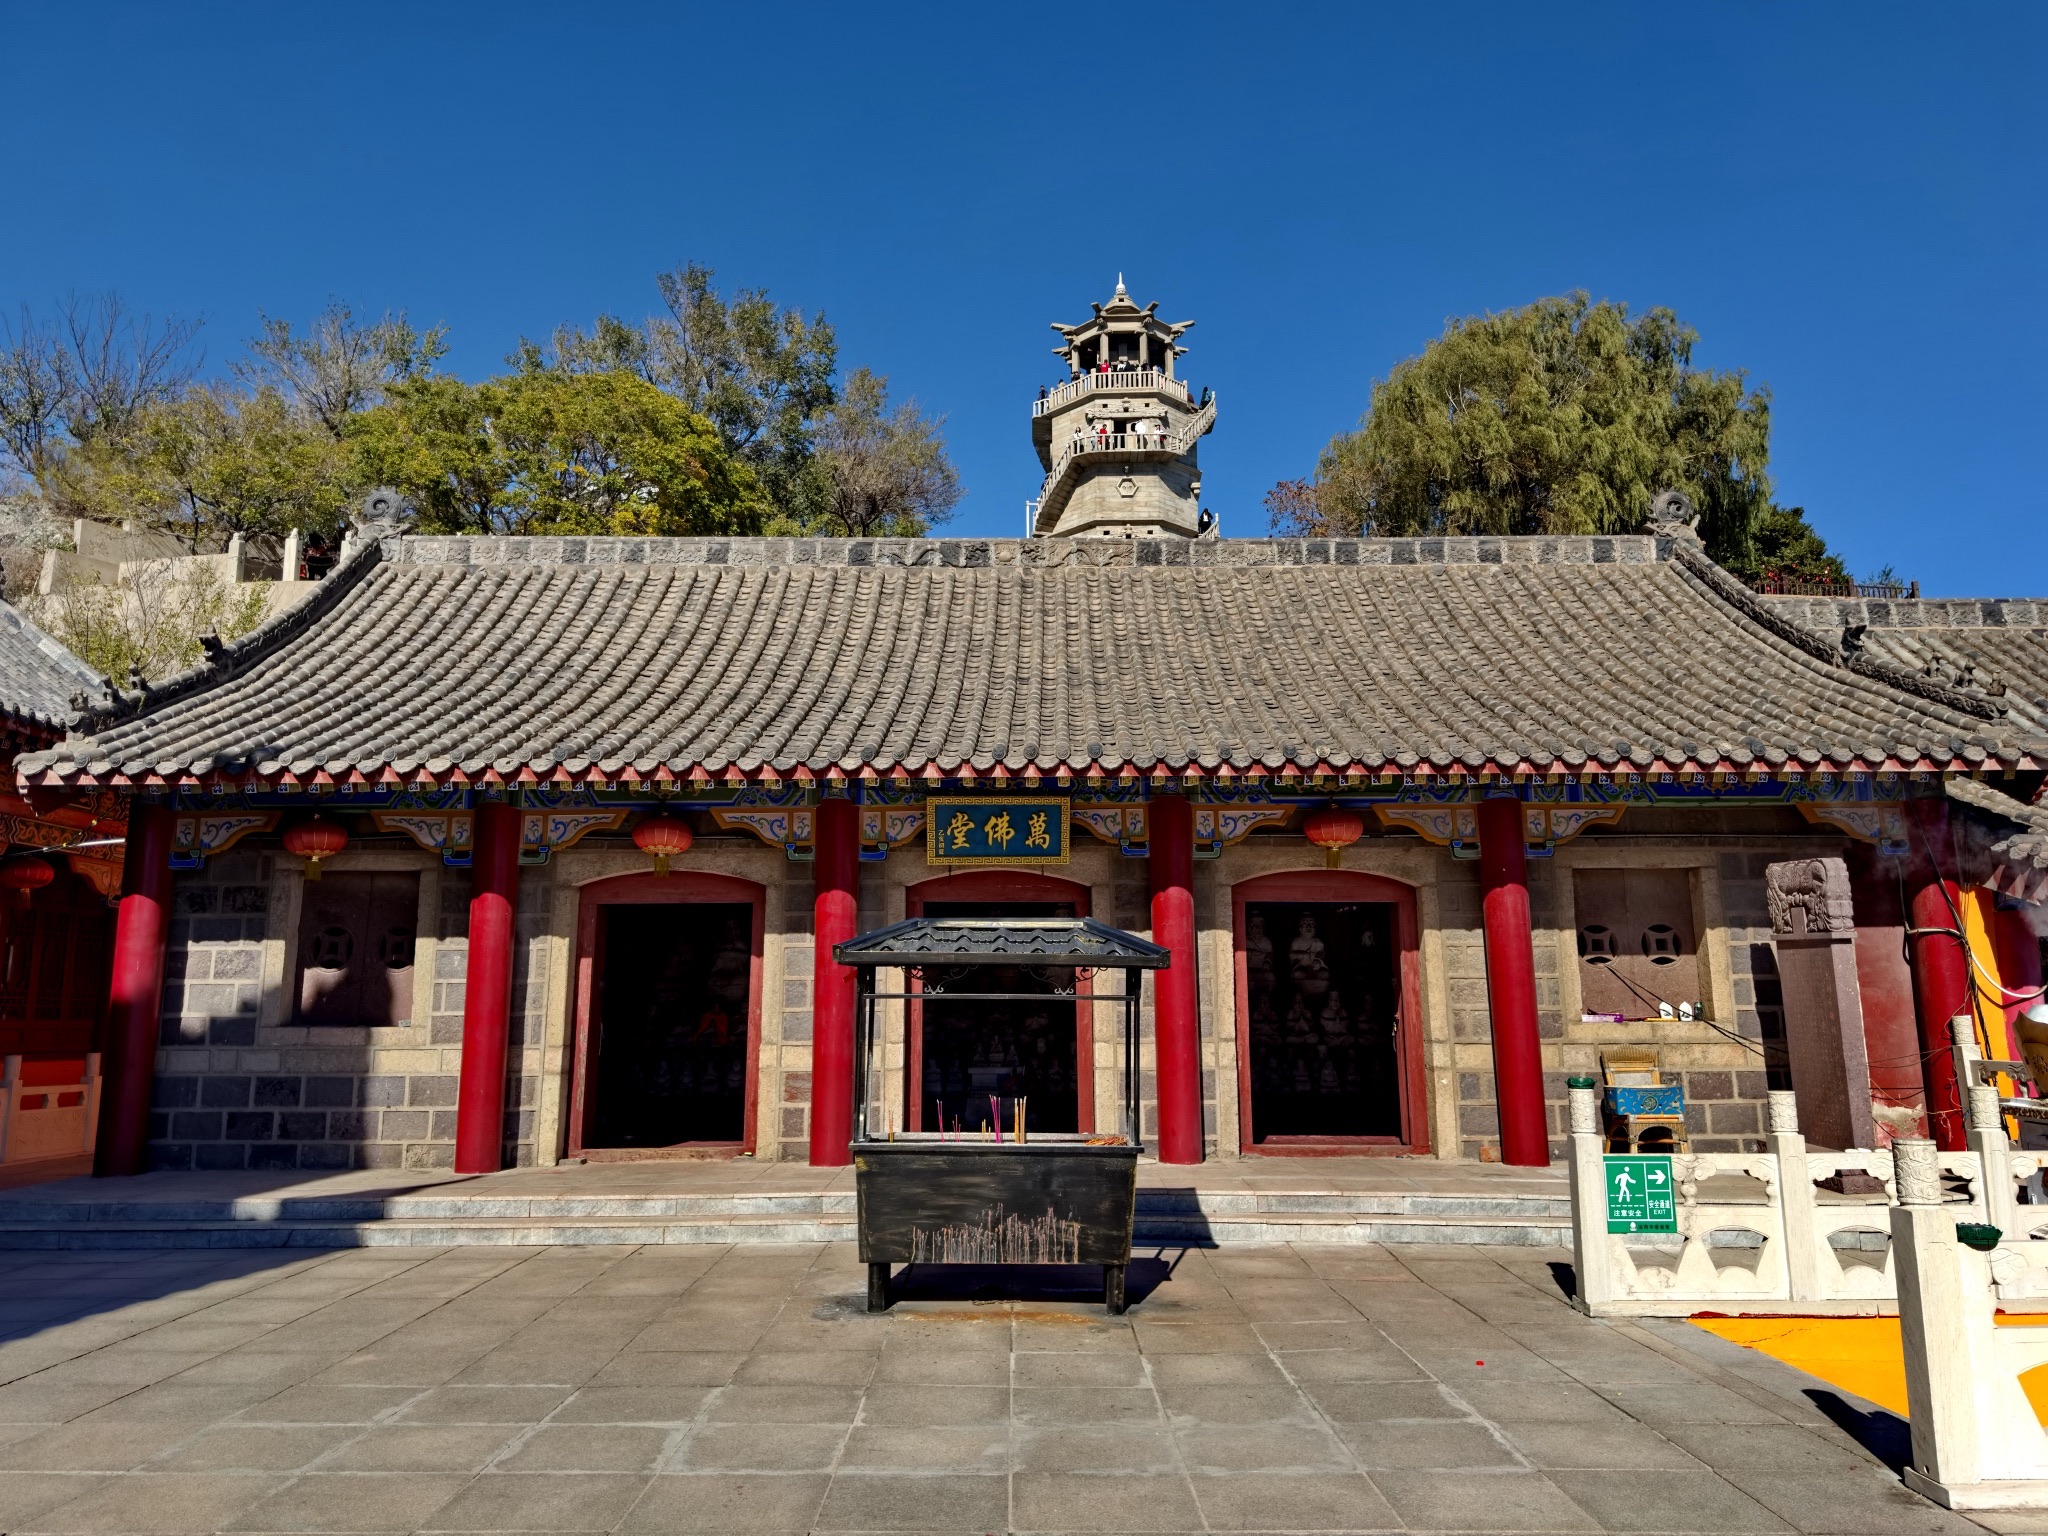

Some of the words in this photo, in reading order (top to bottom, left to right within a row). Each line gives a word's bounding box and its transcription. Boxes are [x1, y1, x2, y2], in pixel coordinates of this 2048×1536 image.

[946, 811, 1051, 851] 萬佛堂
[1648, 1199, 1671, 1209] 安全通道
[1613, 1209, 1642, 1217] 注意安全
